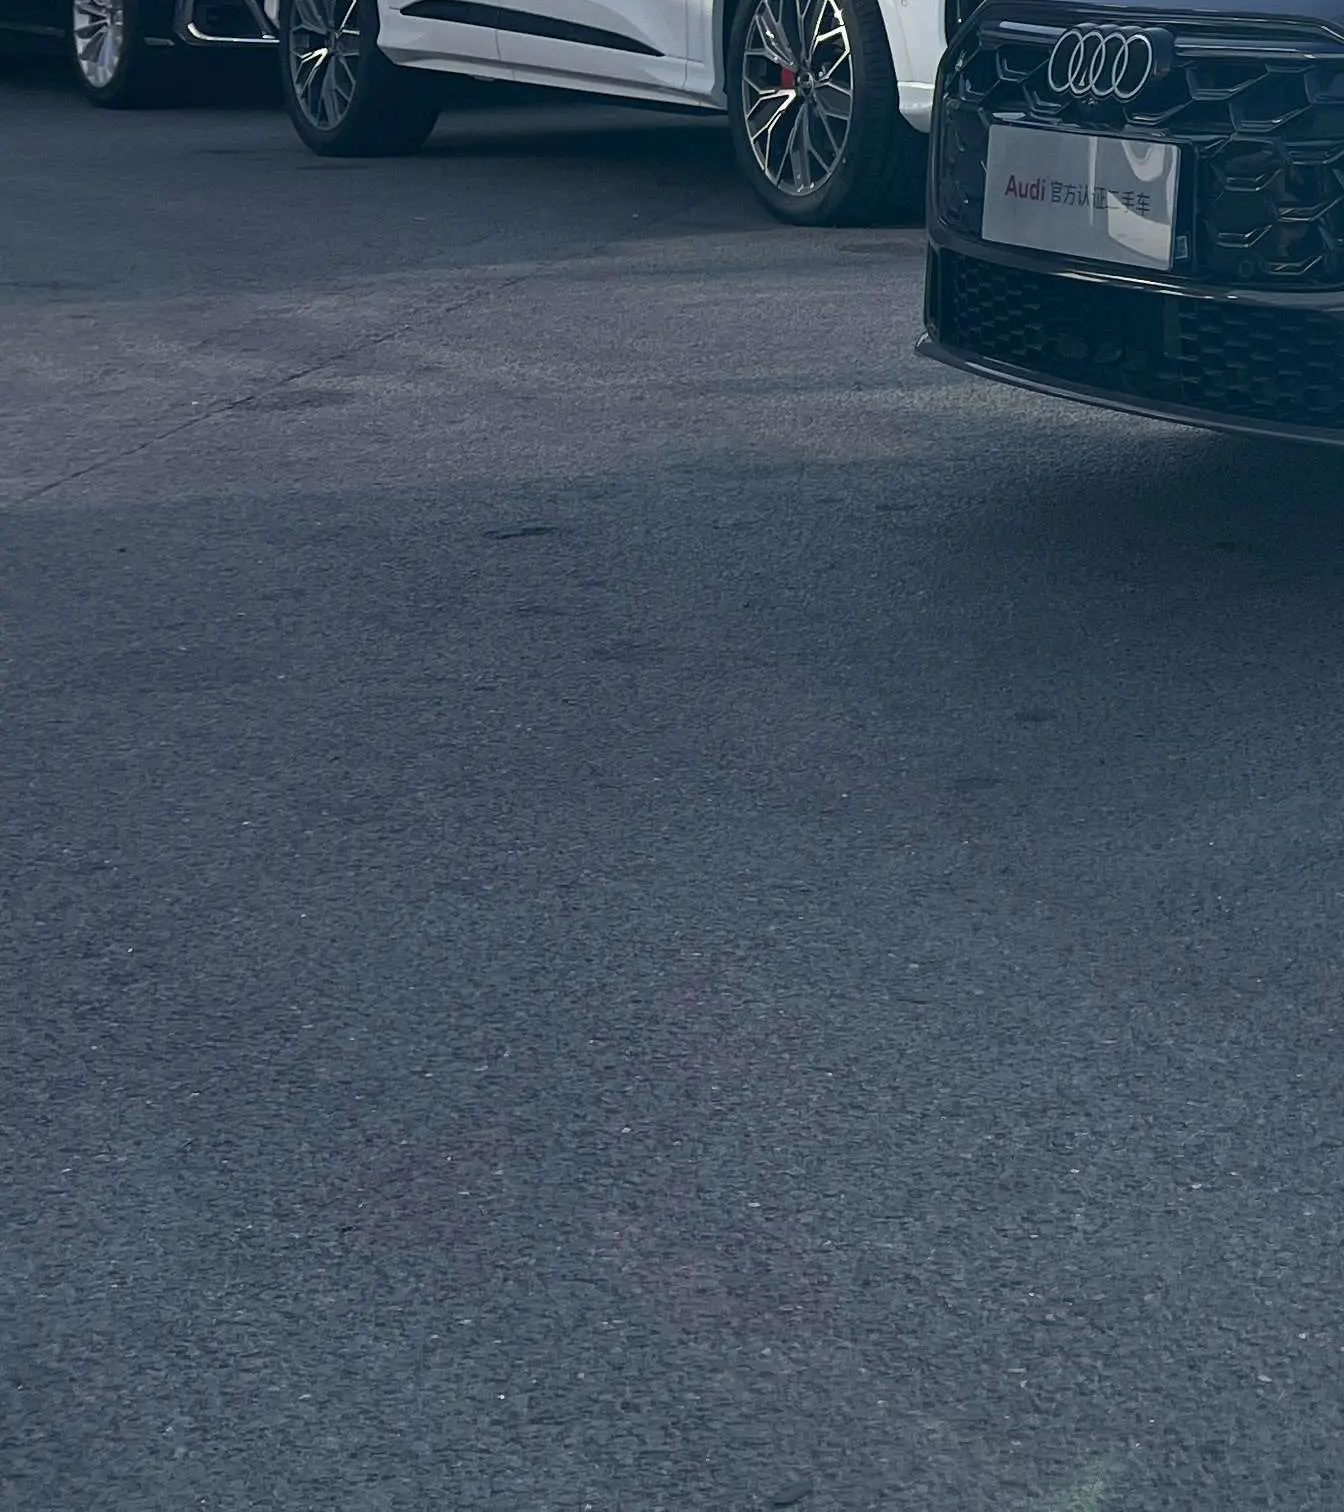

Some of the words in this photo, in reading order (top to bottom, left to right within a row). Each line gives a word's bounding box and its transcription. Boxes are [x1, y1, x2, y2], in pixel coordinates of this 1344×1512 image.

[1004, 174, 1046, 202] Audi
[1050, 181, 1151, 216] 官方认证二手车
